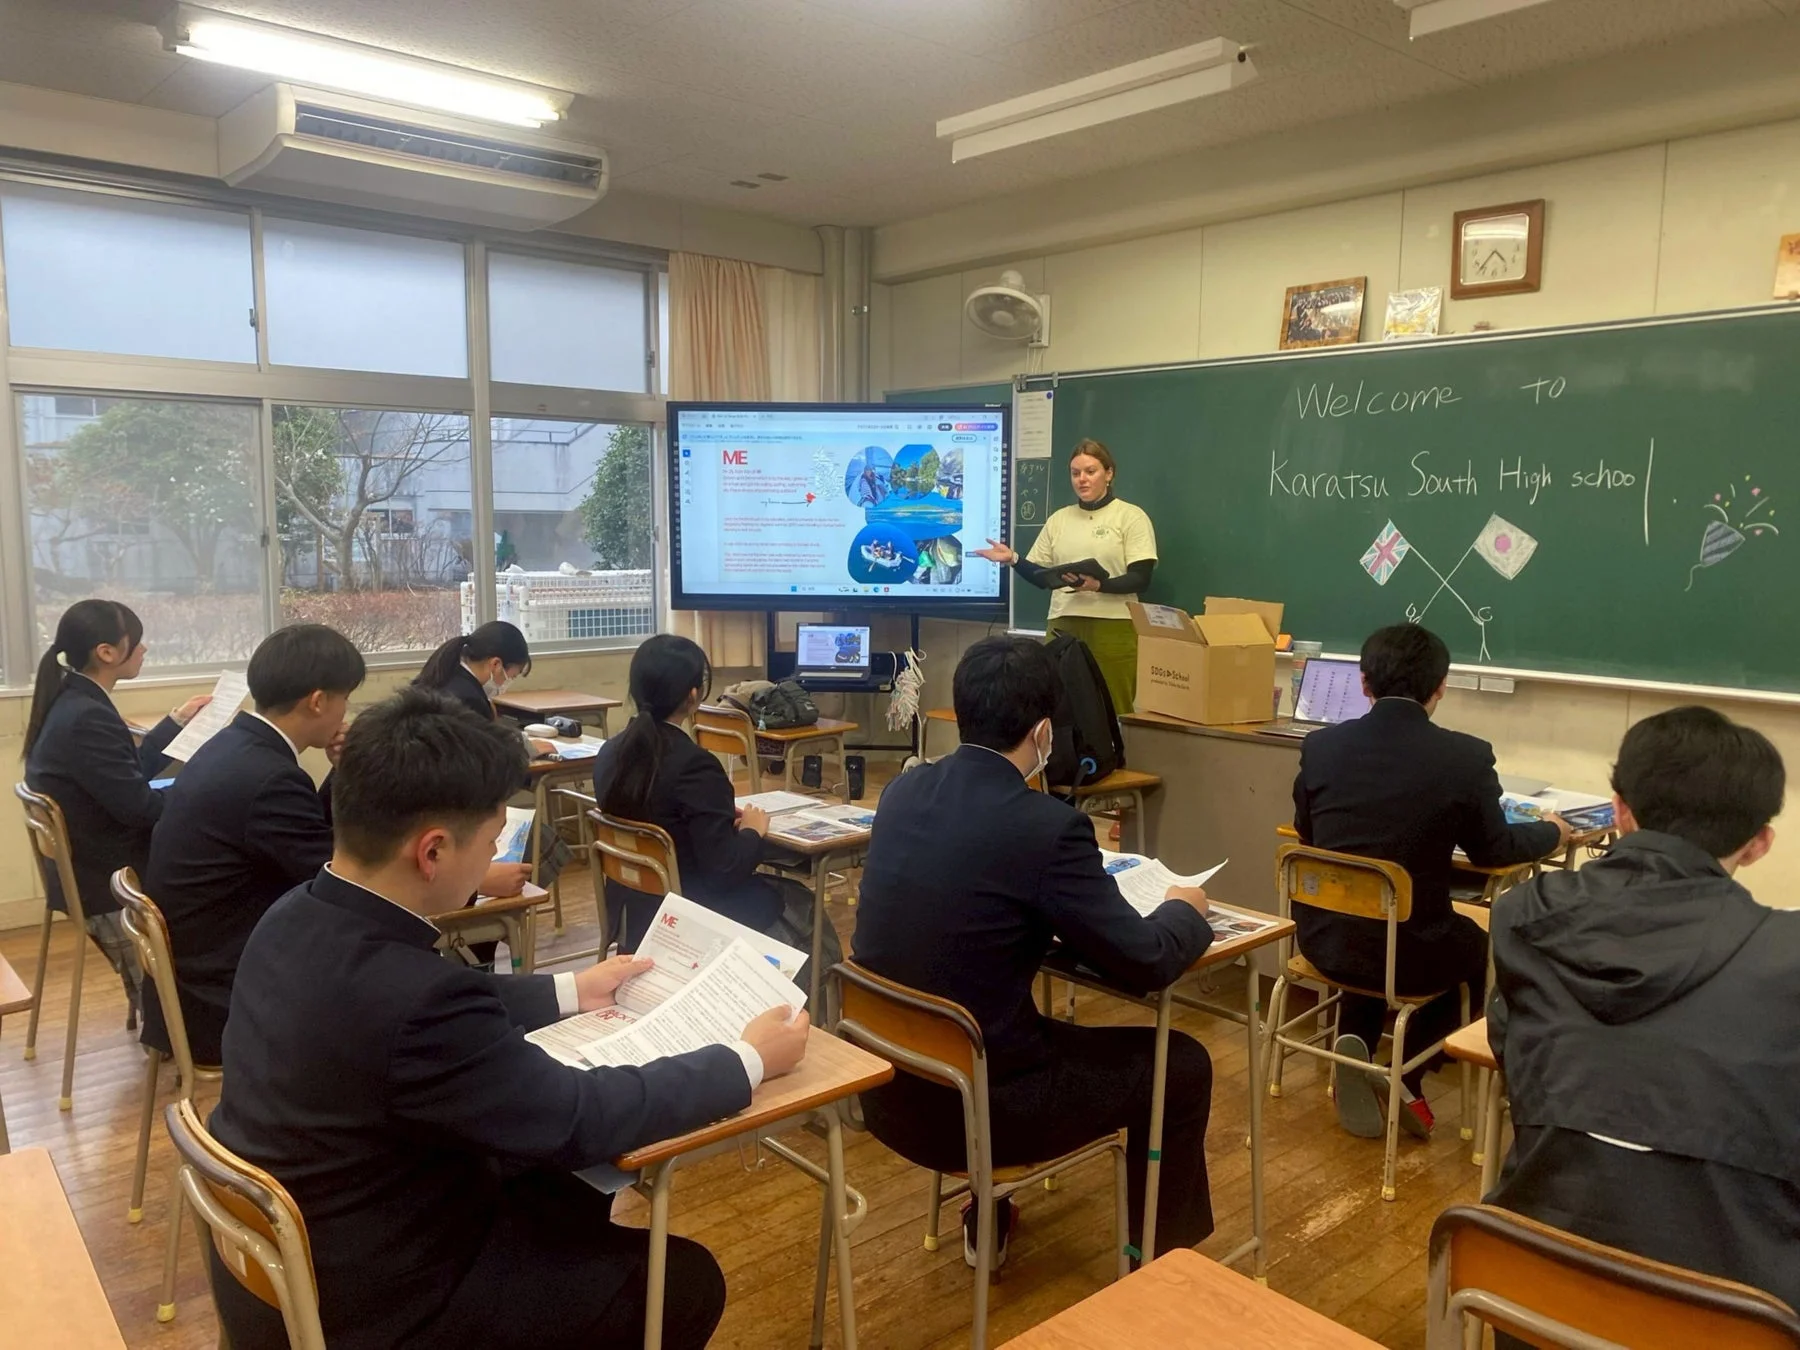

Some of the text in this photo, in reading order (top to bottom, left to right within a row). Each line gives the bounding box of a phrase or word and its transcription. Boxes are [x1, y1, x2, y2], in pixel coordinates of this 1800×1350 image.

[1297, 379, 1463, 420] Welcome
[723, 450, 748, 465] ME
[1269, 449, 1389, 500] Karatsu
[1407, 450, 1478, 496] South
[1500, 456, 1552, 505] High
[661, 913, 679, 929] ME
